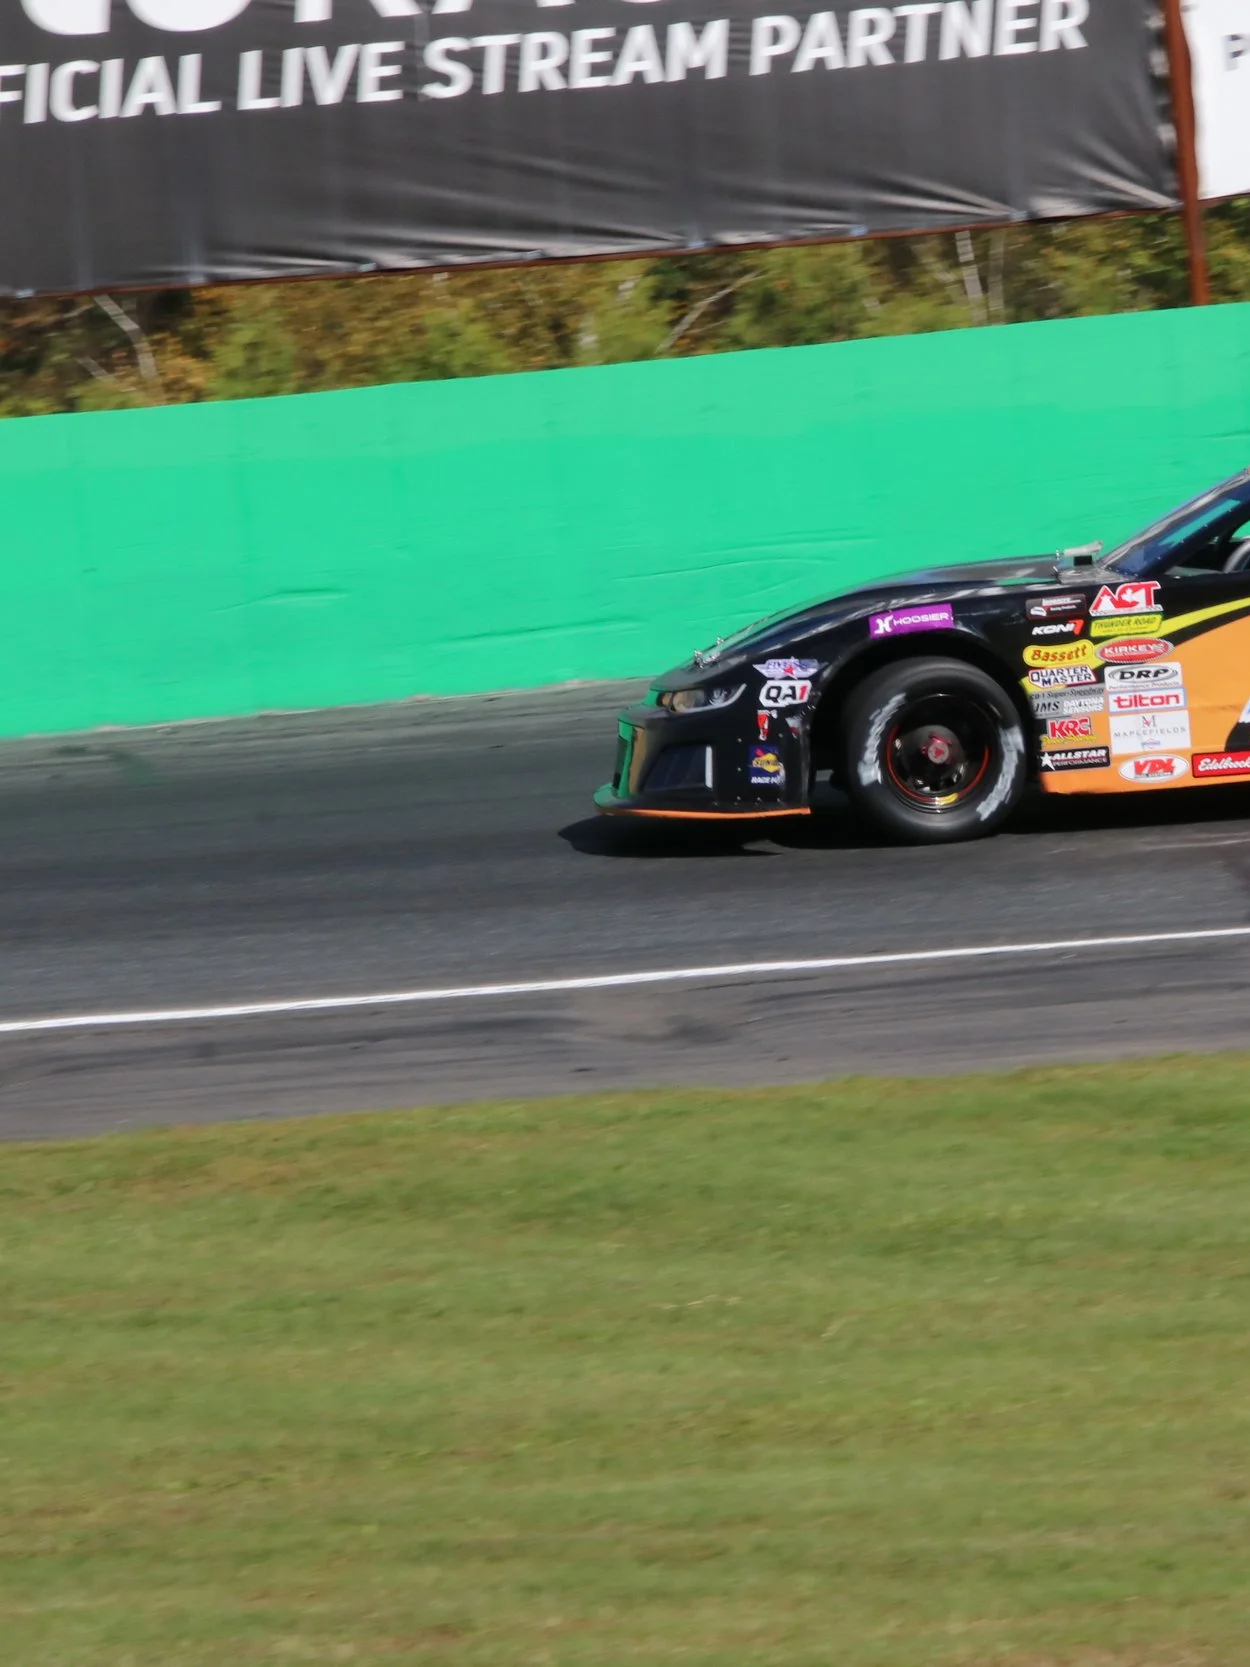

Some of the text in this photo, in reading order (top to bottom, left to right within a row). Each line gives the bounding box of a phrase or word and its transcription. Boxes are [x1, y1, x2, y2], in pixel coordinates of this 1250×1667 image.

[237, 41, 405, 111] LIVE
[420, 18, 729, 100] STREAM
[749, 0, 1089, 76] PARTNER
[1090, 581, 1162, 612] ACT
[893, 612, 950, 626] HOOSIER
[1094, 618, 1131, 629] THUNDER
[1133, 616, 1157, 627] ROAD
[1032, 624, 1075, 635] KONI
[1031, 644, 1087, 661] Bassett
[1104, 644, 1156, 655] KIRKEY
[1030, 666, 1088, 682] QUARTER
[1042, 674, 1092, 687] MASTER
[1120, 668, 1169, 680] DRP
[765, 685, 809, 703] QA1
[1113, 694, 1180, 709] tilton
[1049, 717, 1090, 738] KRC
[1113, 726, 1187, 738] MAPLEFIELDS
[1052, 749, 1107, 761] ALLSTAR
